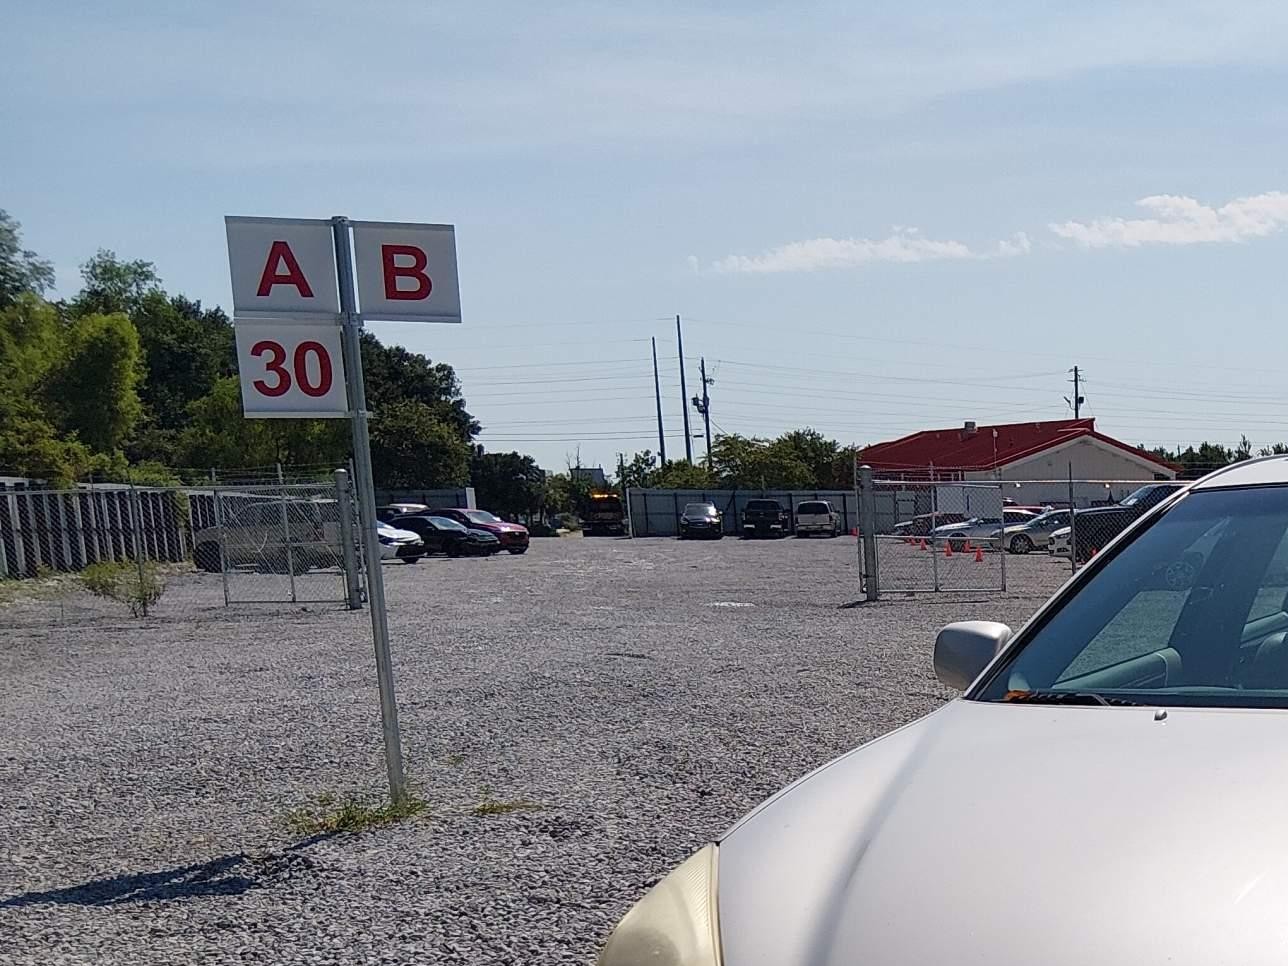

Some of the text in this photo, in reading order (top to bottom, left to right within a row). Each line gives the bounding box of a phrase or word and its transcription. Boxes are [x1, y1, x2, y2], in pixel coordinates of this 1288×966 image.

[256, 240, 315, 298] A
[381, 244, 433, 301] B
[250, 340, 333, 398] 30
